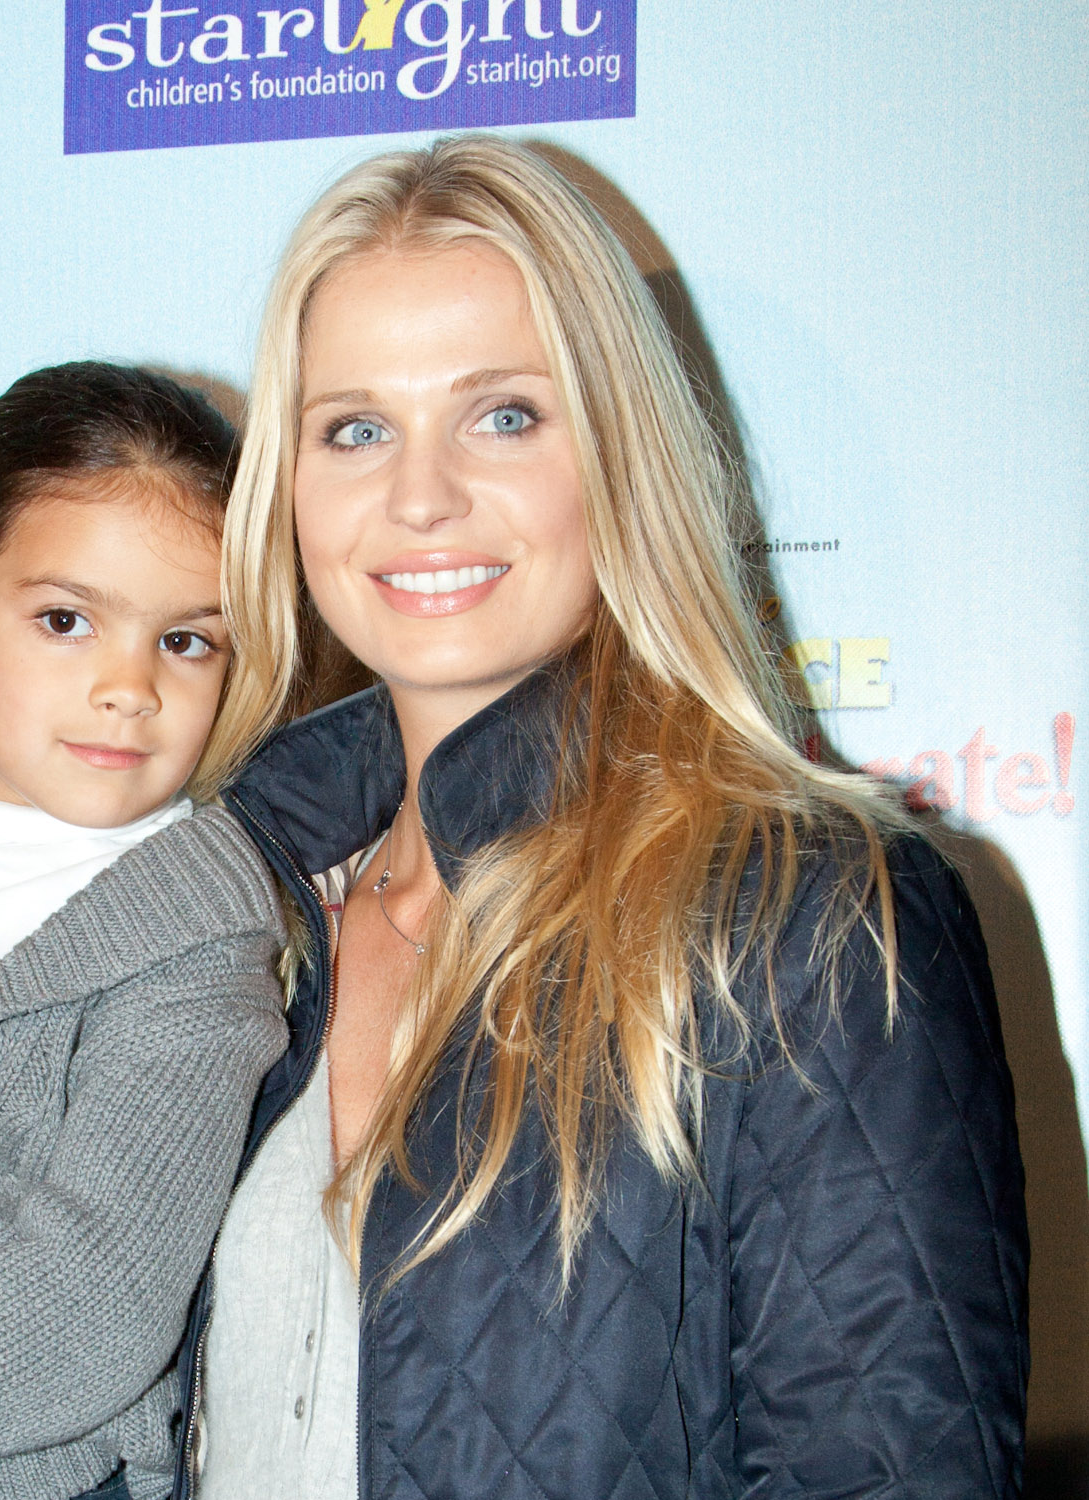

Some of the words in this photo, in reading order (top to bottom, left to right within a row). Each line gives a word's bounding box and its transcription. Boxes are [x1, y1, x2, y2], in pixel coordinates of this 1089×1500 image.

[126, 73, 242, 108] children's
[250, 66, 386, 100] foundation
[466, 51, 621, 88] starlight.org
